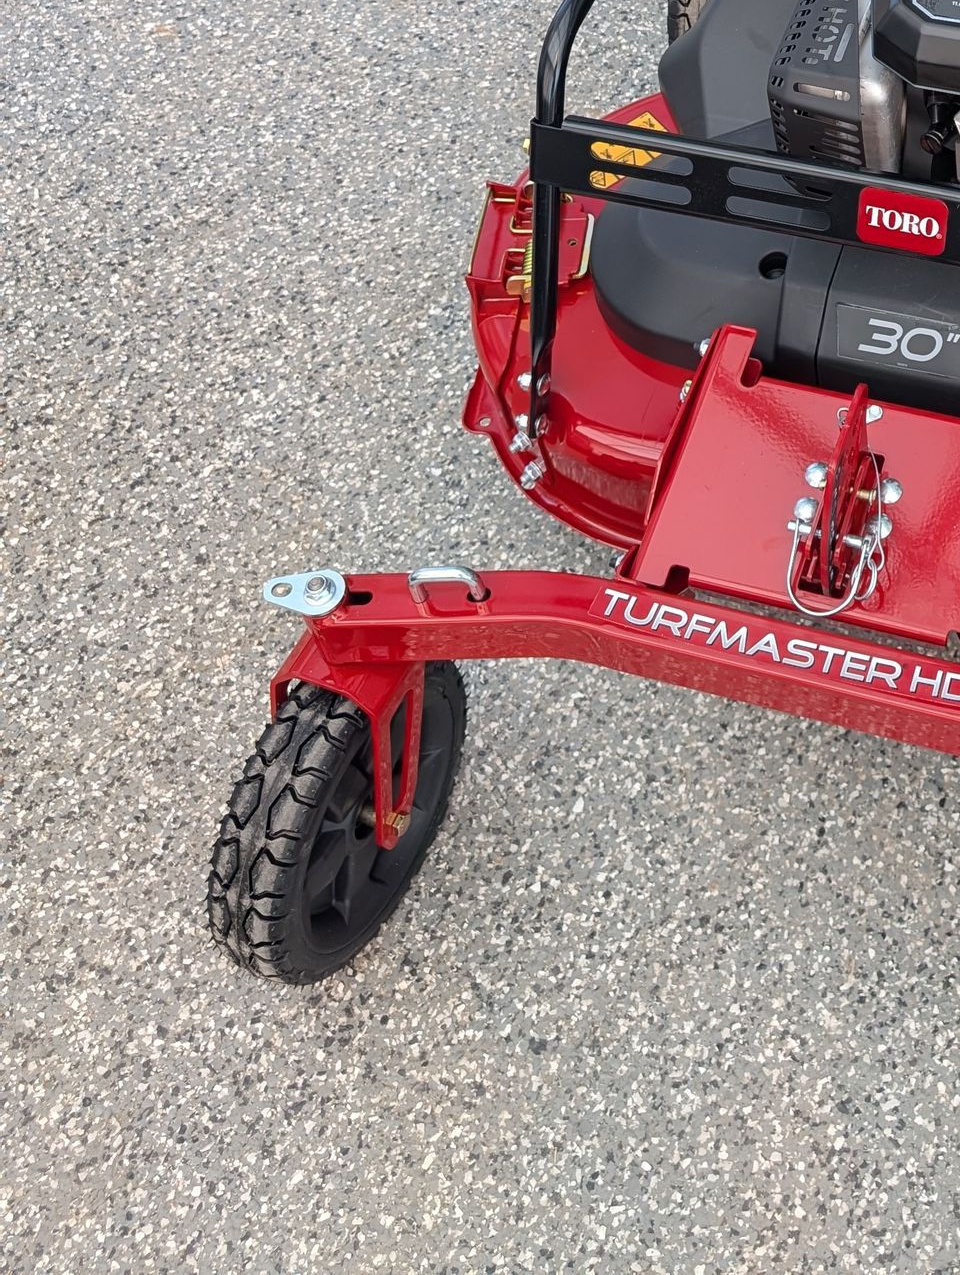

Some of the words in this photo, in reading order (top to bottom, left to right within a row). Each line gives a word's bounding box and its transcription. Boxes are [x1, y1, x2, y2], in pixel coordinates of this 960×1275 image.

[865, 205, 940, 238] TORO
[857, 317, 960, 362] 30"
[603, 588, 903, 689] TURFMASTER
